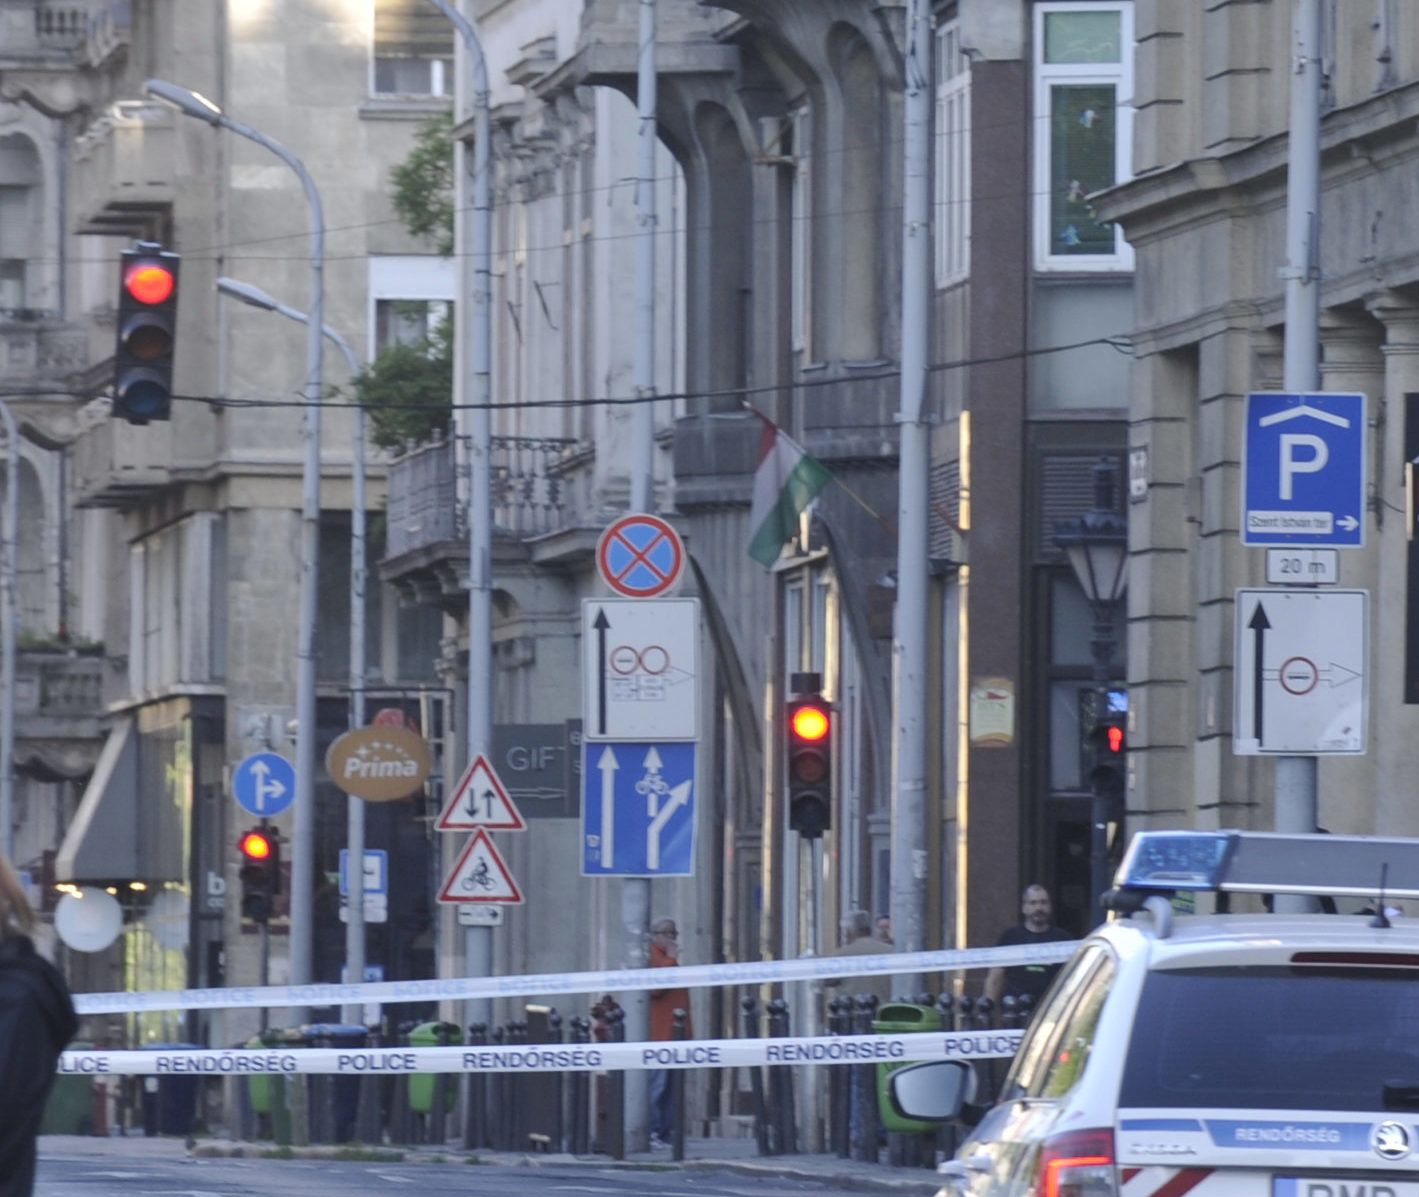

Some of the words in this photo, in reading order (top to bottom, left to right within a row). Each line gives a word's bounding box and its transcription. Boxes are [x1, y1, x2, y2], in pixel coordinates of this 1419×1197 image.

[1280, 558, 1303, 574] 20
[344, 756, 419, 780] Prima
[58, 1056, 110, 1072] LICE
[156, 1050, 297, 1072] RENDŐRSÉG
[338, 1054, 418, 1071] POLICE
[463, 1046, 602, 1069] RENDŐRSÉG
[642, 1046, 721, 1065] POLICE
[766, 1036, 905, 1061] RENDŐRSÉG
